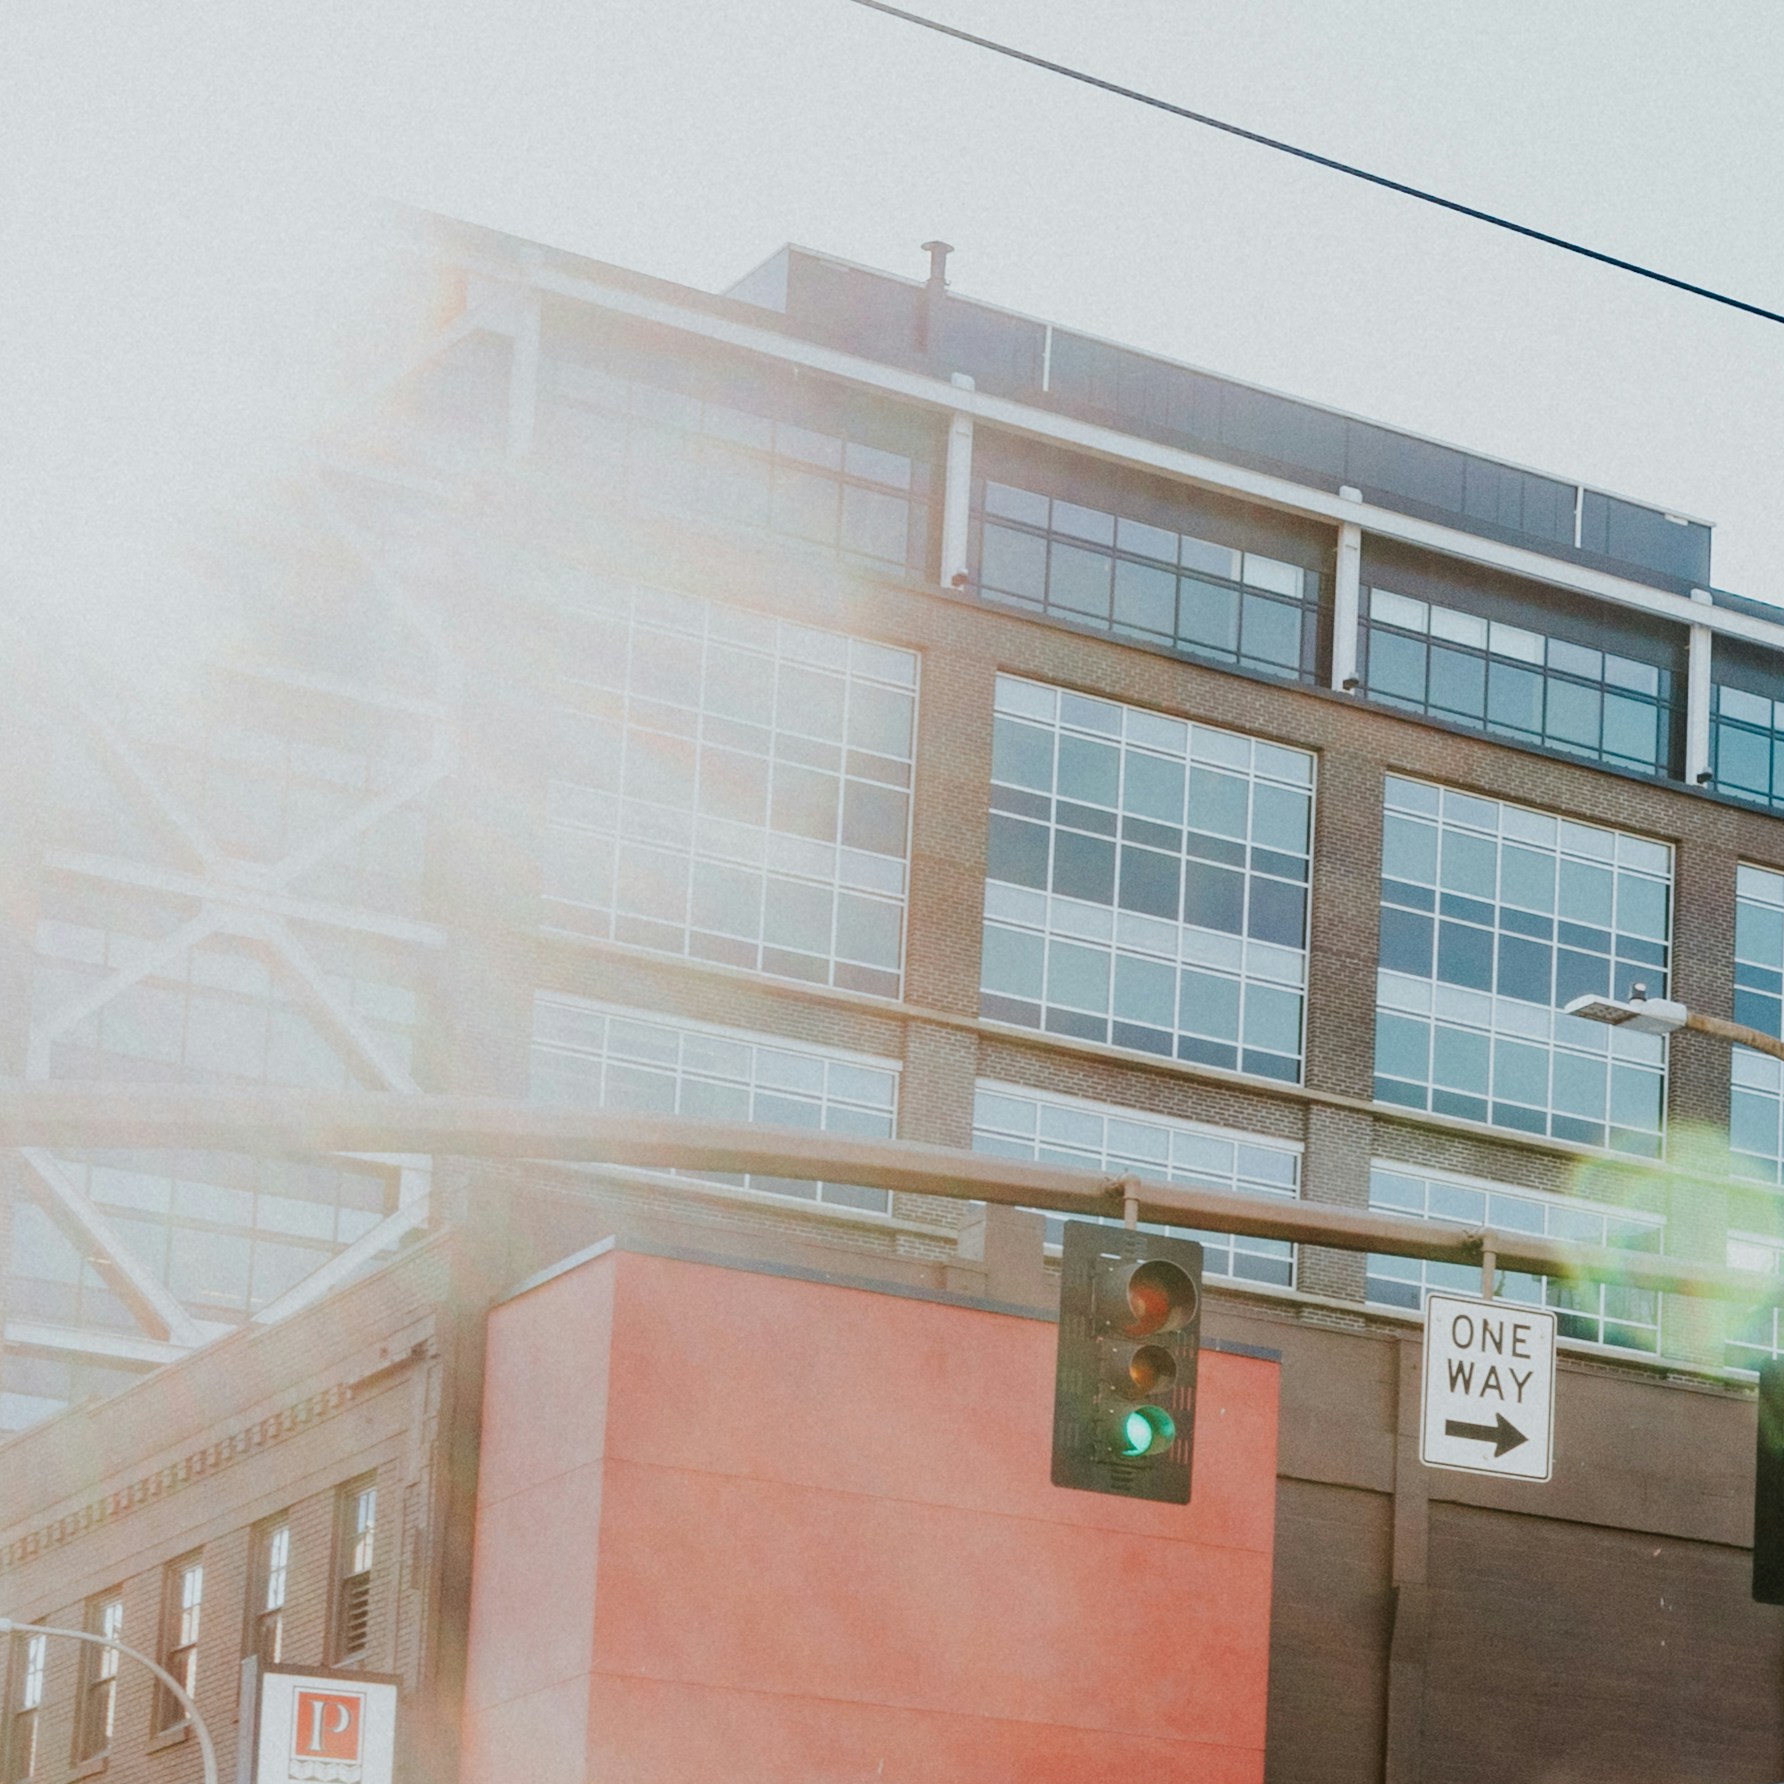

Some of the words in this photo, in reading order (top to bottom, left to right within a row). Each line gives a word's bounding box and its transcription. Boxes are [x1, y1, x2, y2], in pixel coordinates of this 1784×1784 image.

[1451, 1314, 1531, 1359] ONE
[1447, 1358, 1534, 1403] WAY
[308, 1699, 352, 1752] P
